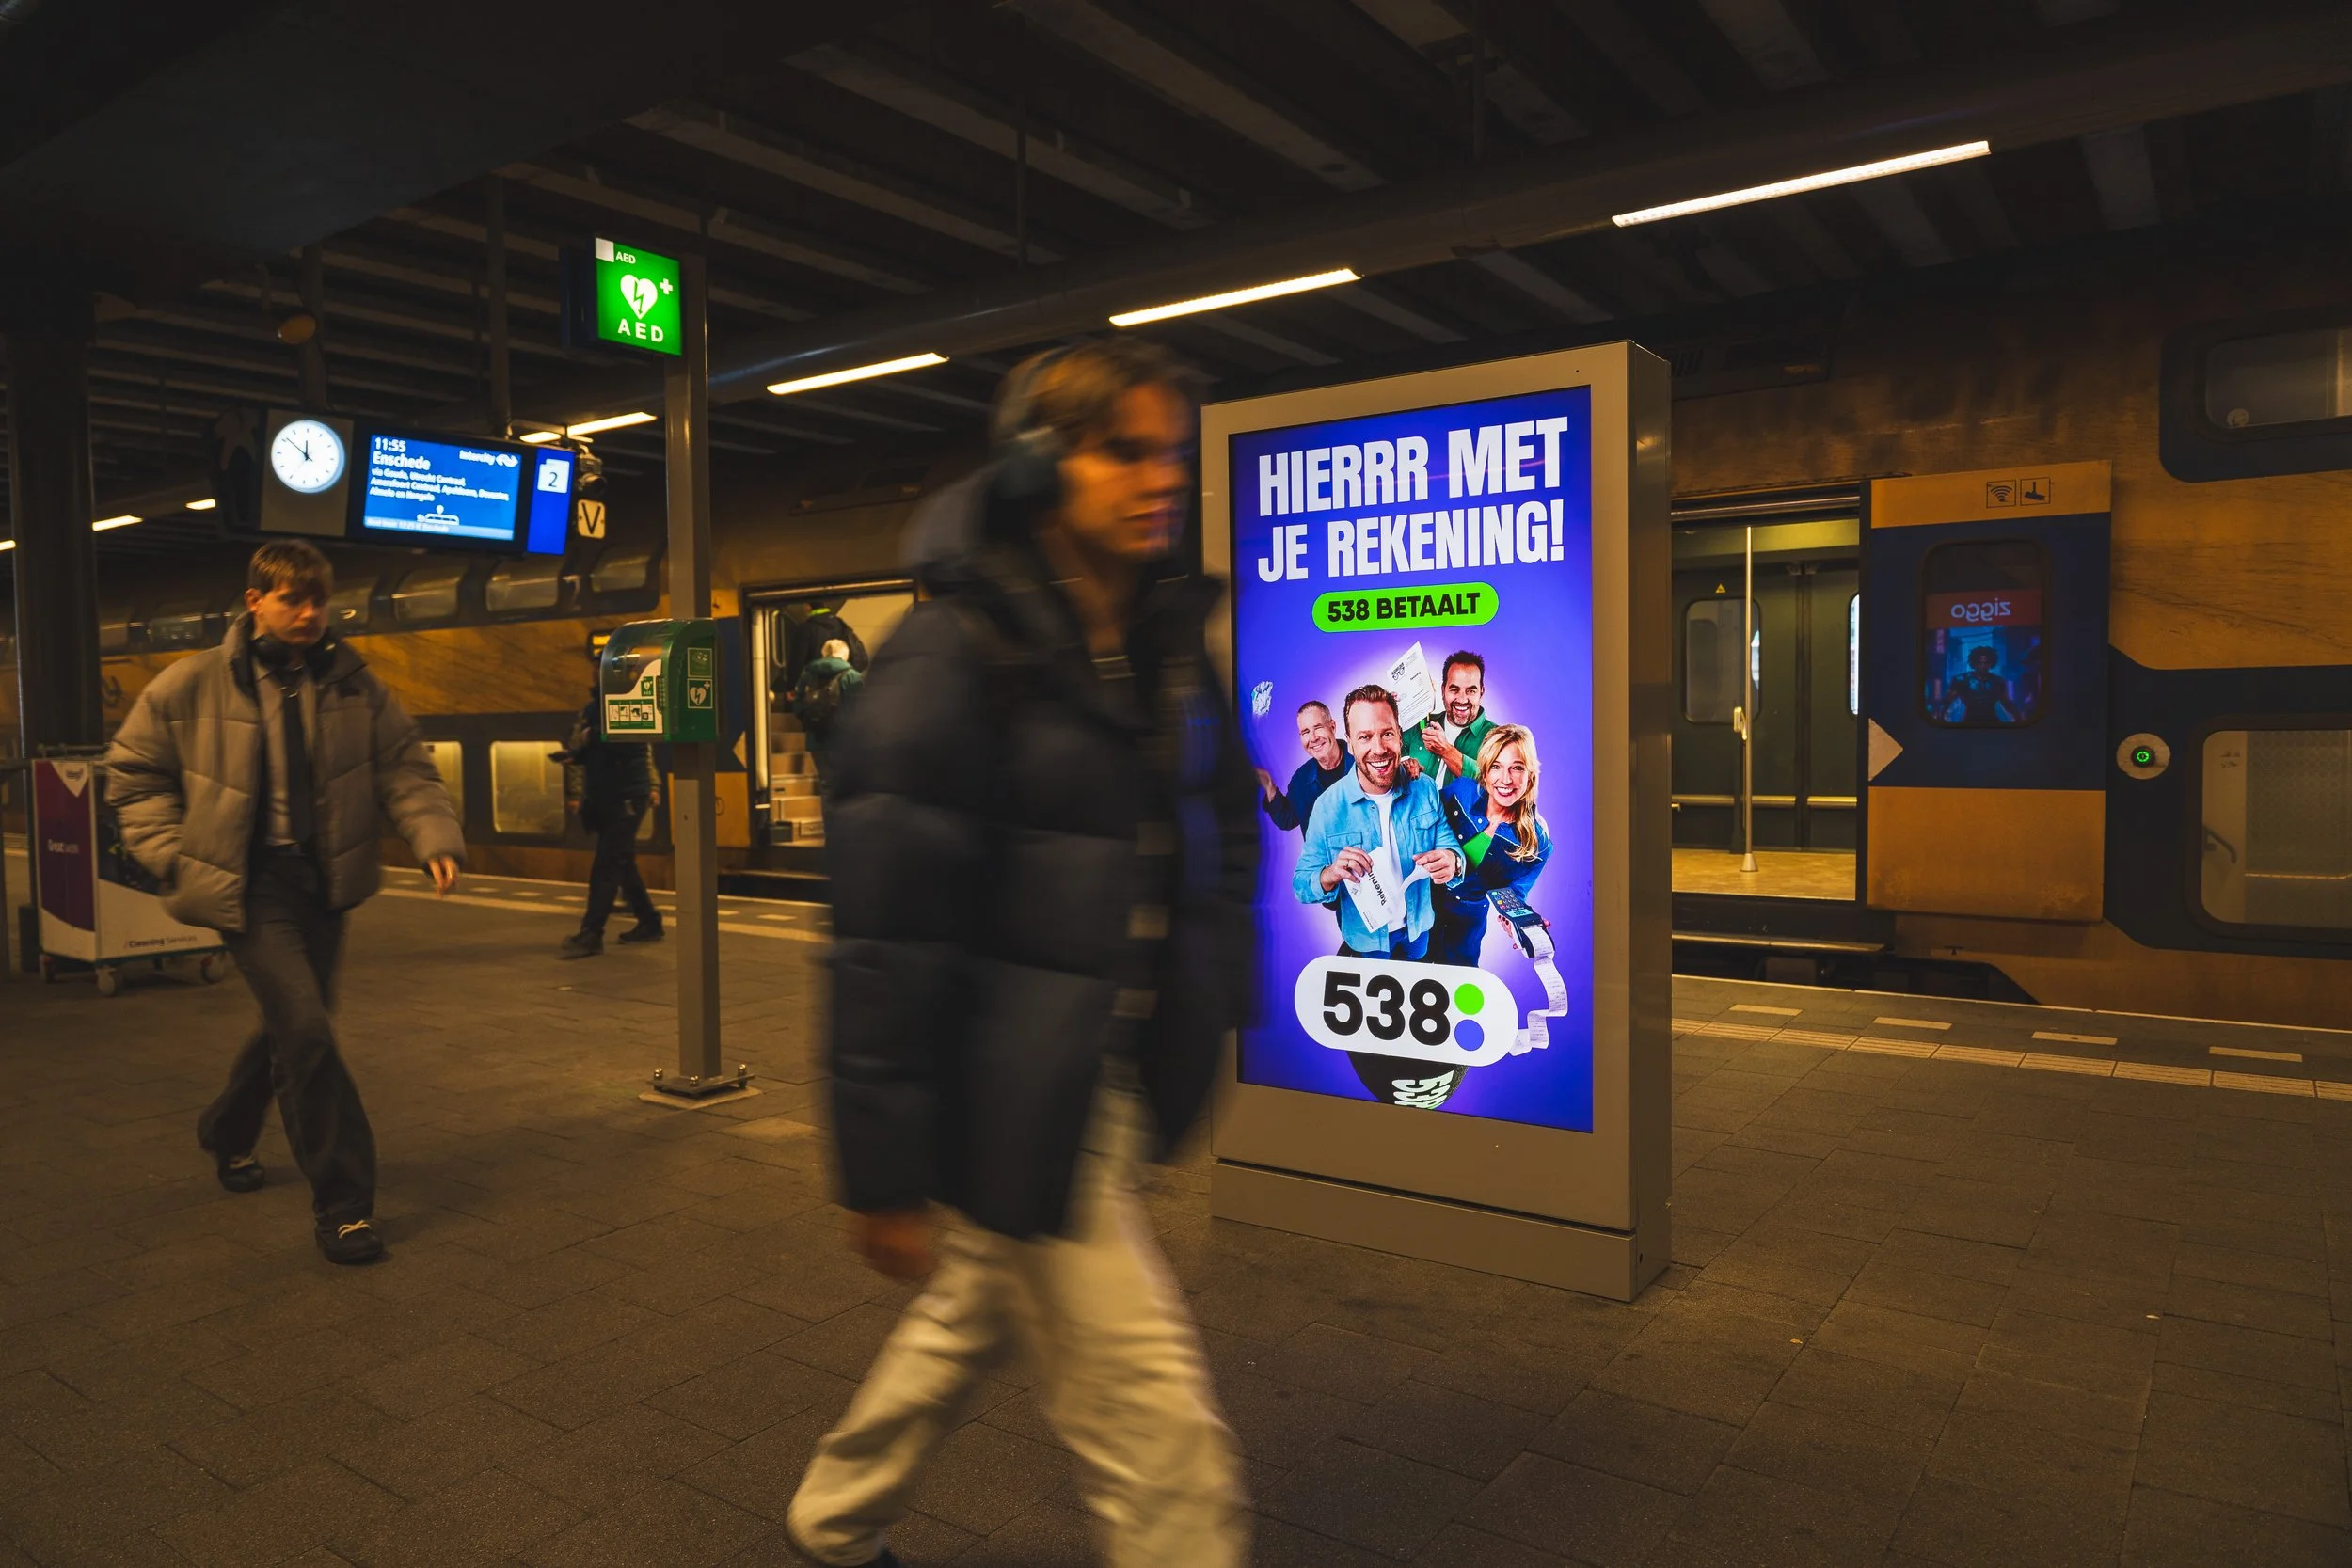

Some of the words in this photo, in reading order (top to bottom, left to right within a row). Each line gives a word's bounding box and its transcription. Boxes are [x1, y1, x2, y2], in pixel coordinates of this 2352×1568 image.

[615, 251, 636, 264] AED
[617, 318, 664, 342] AED
[374, 436, 406, 452] 11:55
[373, 451, 431, 470] Enschede
[1259, 436, 1429, 516] HIERRR
[1448, 416, 1568, 499] MET
[548, 471, 558, 488] 2
[580, 502, 601, 534] V
[1258, 524, 1309, 583] JE
[1327, 499, 1565, 578] REKENING!
[1327, 598, 1370, 622] 538
[1376, 592, 1481, 621] BETAALT
[1368, 871, 1387, 906] Rekenin
[1323, 970, 1450, 1046] 538
